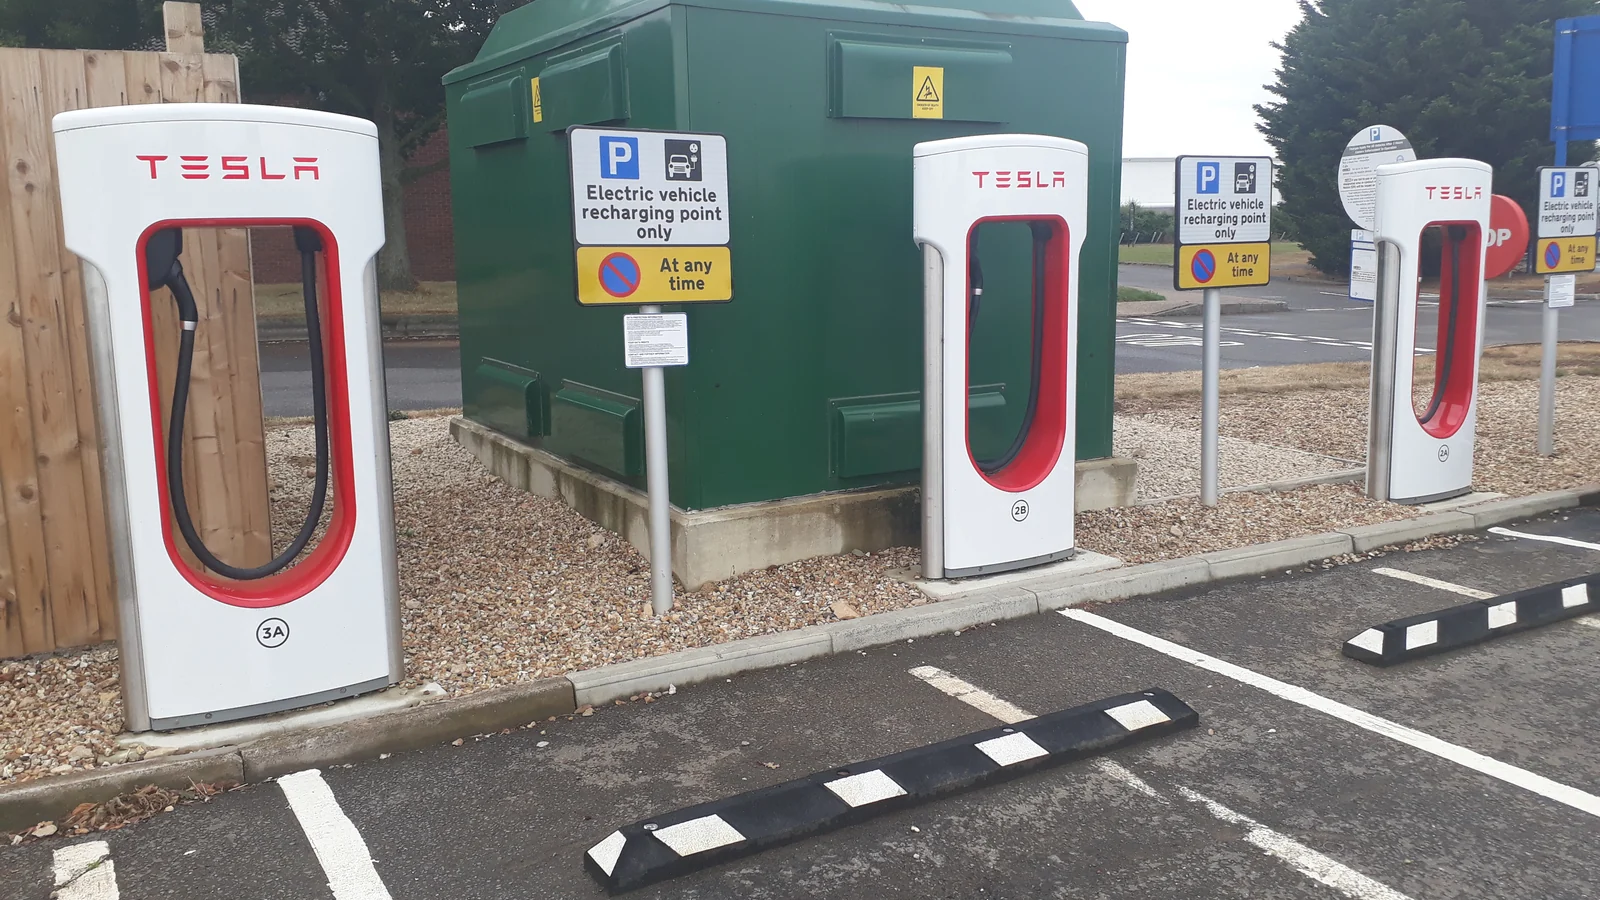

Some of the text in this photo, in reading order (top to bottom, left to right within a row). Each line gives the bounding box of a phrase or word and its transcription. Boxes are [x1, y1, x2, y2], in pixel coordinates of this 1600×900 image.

[608, 141, 632, 175] P
[135, 155, 319, 180] TESLA
[971, 171, 1065, 188] TESLA
[1202, 165, 1216, 191] P
[1553, 175, 1564, 196] P
[586, 184, 717, 202] Electric vehicle
[1424, 186, 1482, 200] TESLA
[1187, 198, 1264, 210] Electric vehicle
[1544, 201, 1569, 211] Electric
[1571, 200, 1593, 210] vehicle
[582, 205, 722, 223] recharging point
[1184, 212, 1266, 226] recharging point
[1541, 212, 1594, 223] recharging point
[636, 224, 672, 242] only
[1215, 227, 1236, 240] only
[1560, 224, 1575, 234] only
[1568, 244, 1588, 254] At any
[1227, 252, 1259, 264] At any
[1570, 255, 1585, 264] time
[660, 257, 712, 275] At any
[1232, 266, 1254, 277] time
[669, 276, 705, 291] time
[1014, 505, 1027, 515] 2B
[262, 625, 285, 639] 3A
